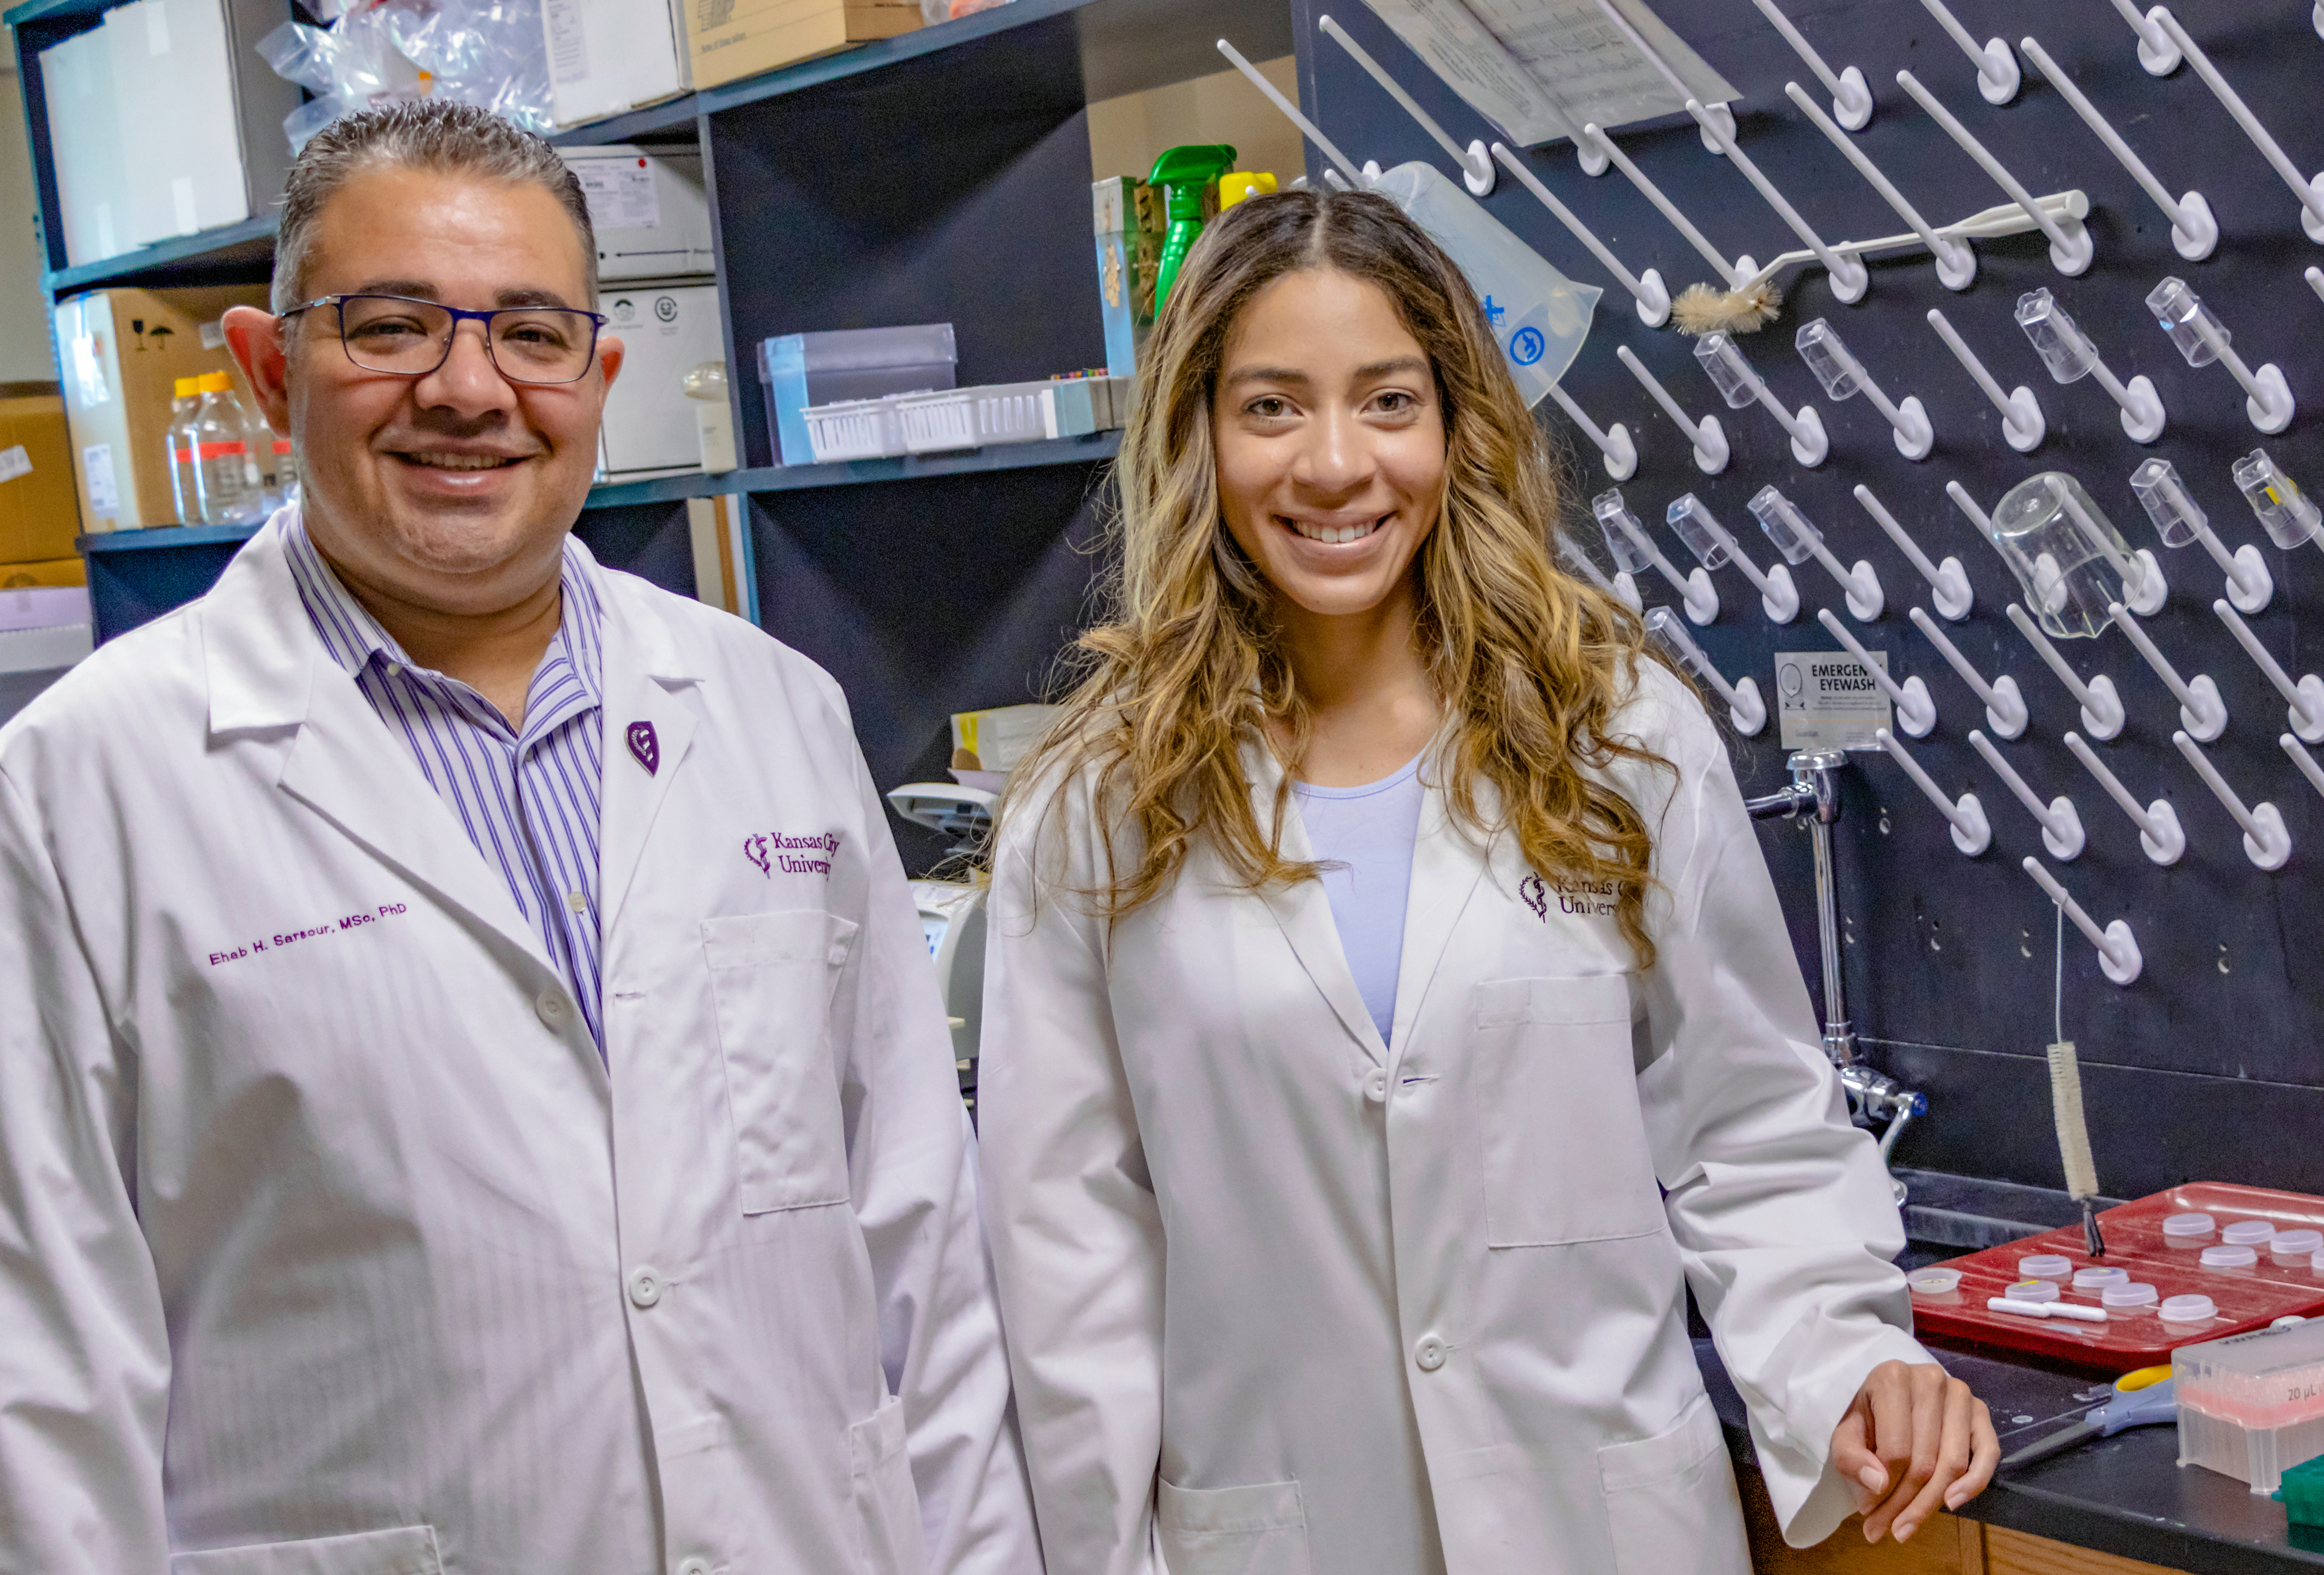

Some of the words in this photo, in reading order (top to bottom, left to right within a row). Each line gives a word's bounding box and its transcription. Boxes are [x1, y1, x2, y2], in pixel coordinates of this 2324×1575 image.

[1812, 664, 1882, 676] EMERGEN
[1820, 678, 1876, 690] EYEWASH
[770, 832, 822, 849] Kansas
[778, 854, 831, 881] Univery
[1558, 896, 1616, 916] Univer
[209, 946, 247, 965] Ehab
[253, 940, 268, 953] H.
[379, 904, 406, 917] PhD
[2288, 1387, 2300, 1401] 20
